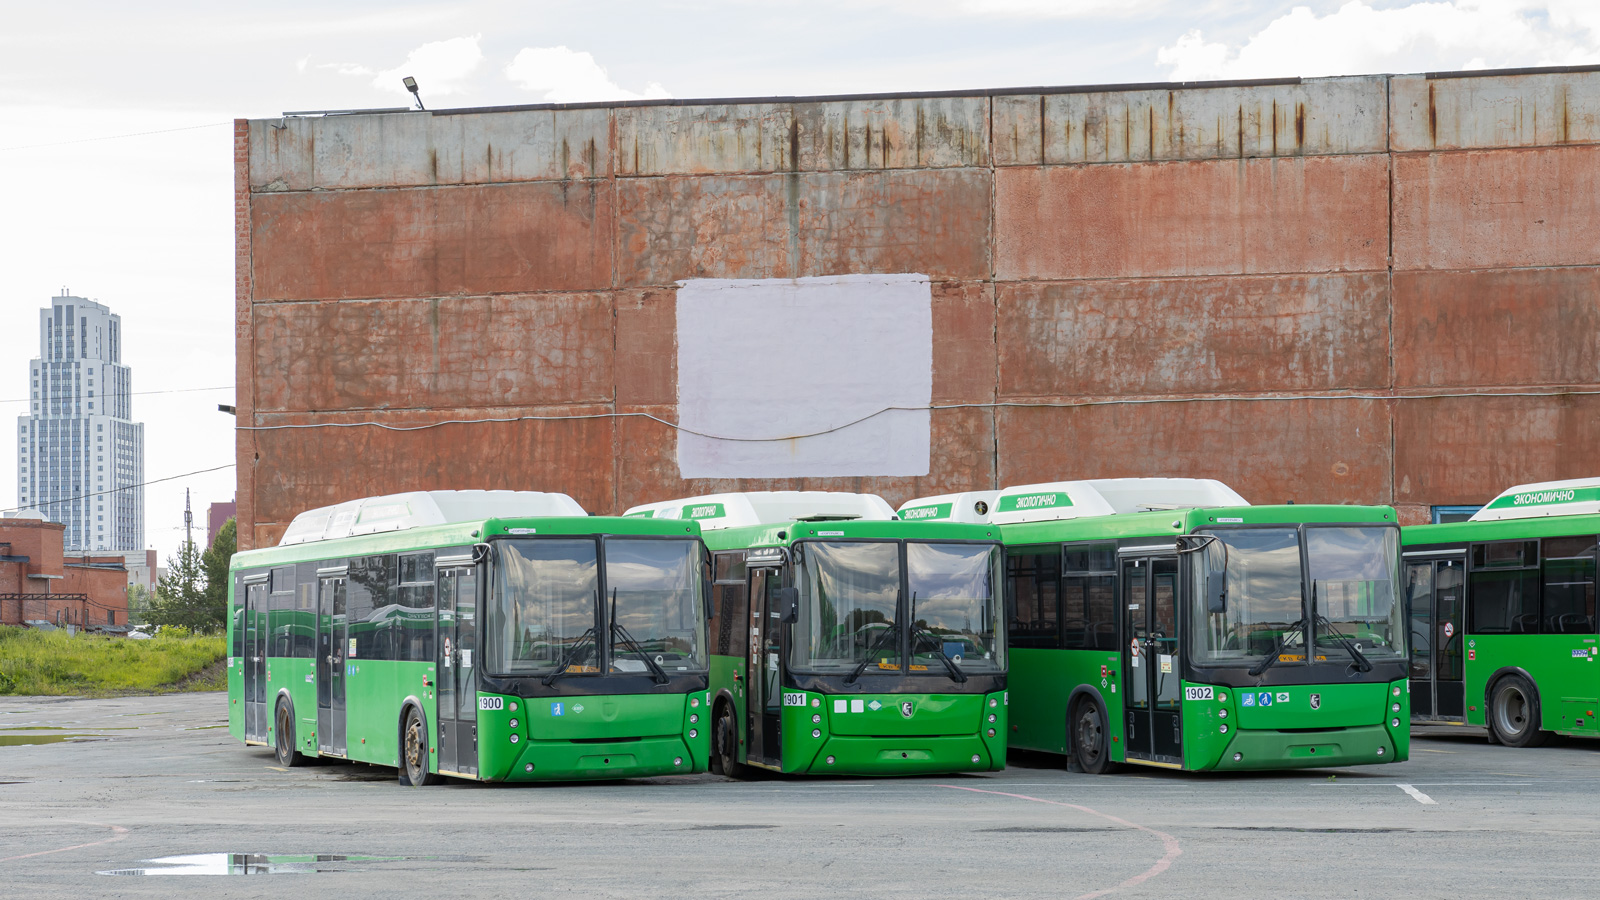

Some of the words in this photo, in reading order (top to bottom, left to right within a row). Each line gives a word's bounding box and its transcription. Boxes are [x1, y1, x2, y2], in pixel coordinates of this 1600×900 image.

[1015, 494, 1056, 508] ЭКОЛОГИЧНО
[1513, 490, 1575, 505] ЭКОНОМИЧНО
[1186, 687, 1212, 699] 1902
[479, 697, 501, 709] 1900
[783, 694, 803, 705] 1901
